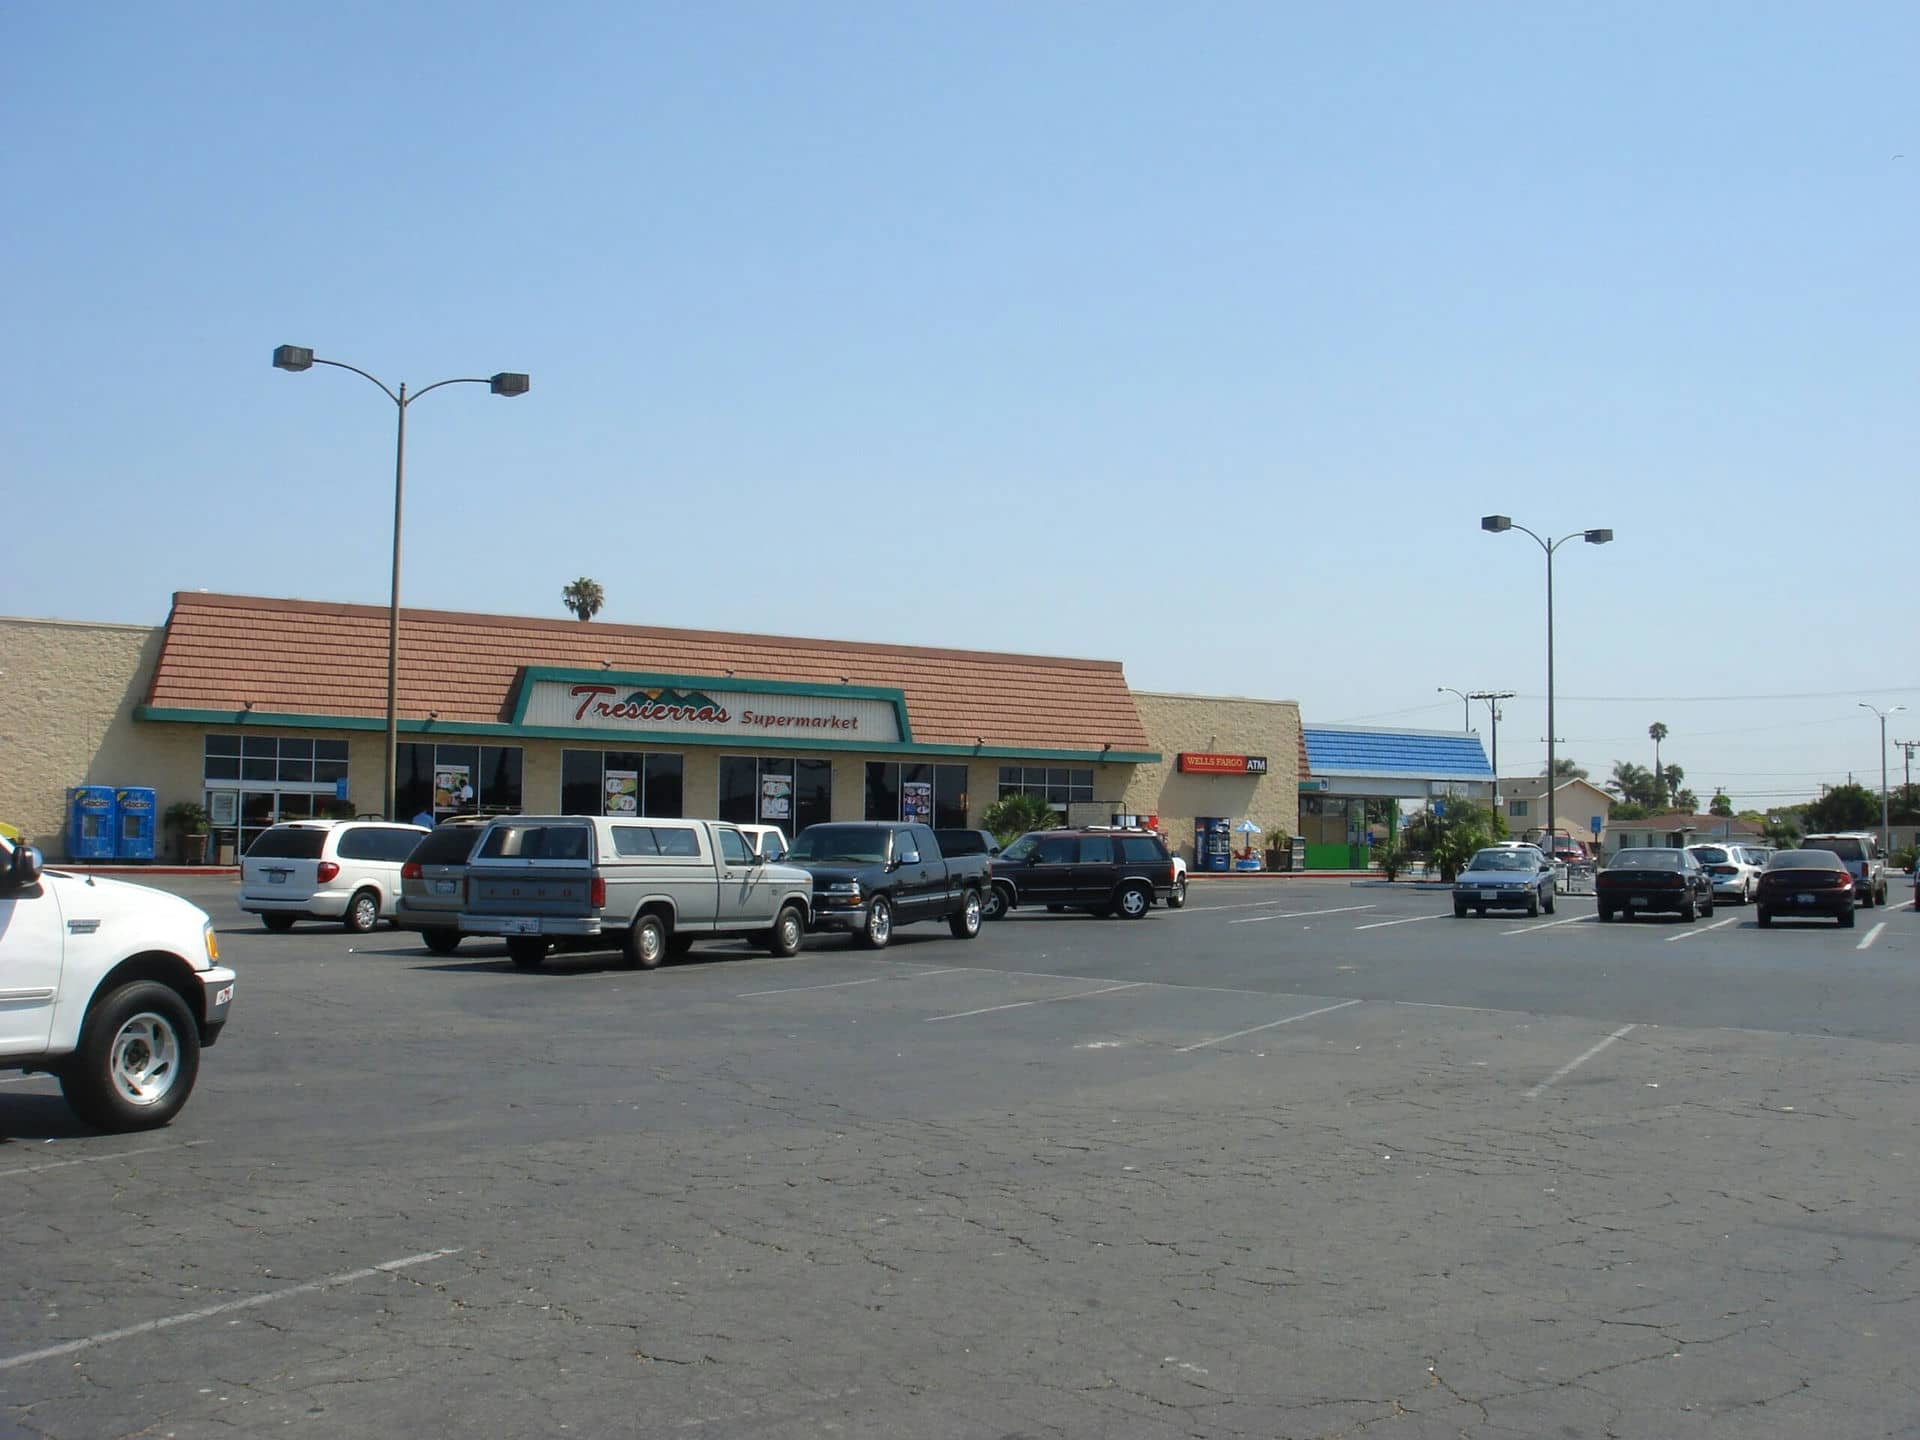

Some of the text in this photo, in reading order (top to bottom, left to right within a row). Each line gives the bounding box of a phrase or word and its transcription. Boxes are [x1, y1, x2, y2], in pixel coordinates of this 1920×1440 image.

[570, 685, 859, 731] Tresierras Supermarket
[1187, 756, 1266, 771] WELLS FARGO ATM
